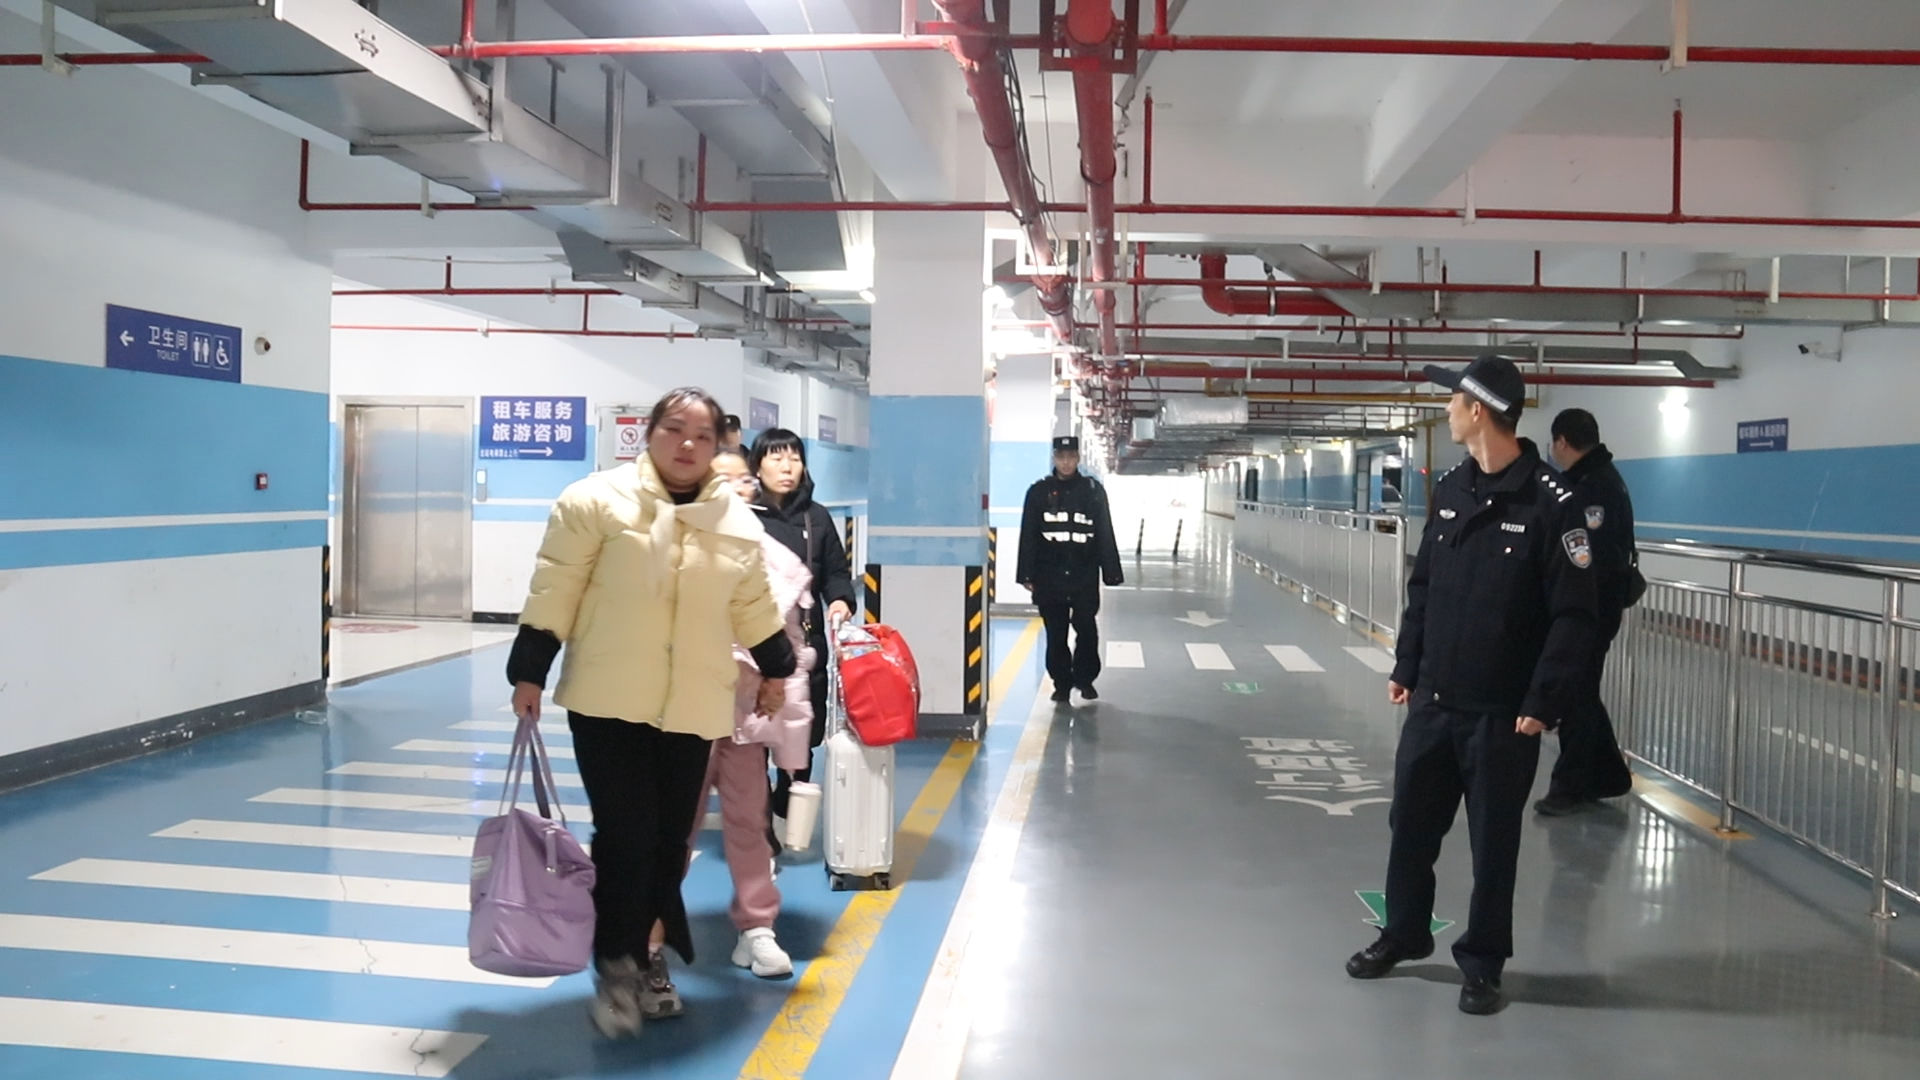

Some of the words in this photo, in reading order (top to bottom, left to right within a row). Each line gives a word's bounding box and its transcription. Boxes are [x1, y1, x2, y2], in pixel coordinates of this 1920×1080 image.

[148, 325, 188, 351] 卫生间
[156, 349, 179, 361] TOILET
[492, 400, 573, 420] 租车服务
[491, 422, 573, 443] 旅游咨询
